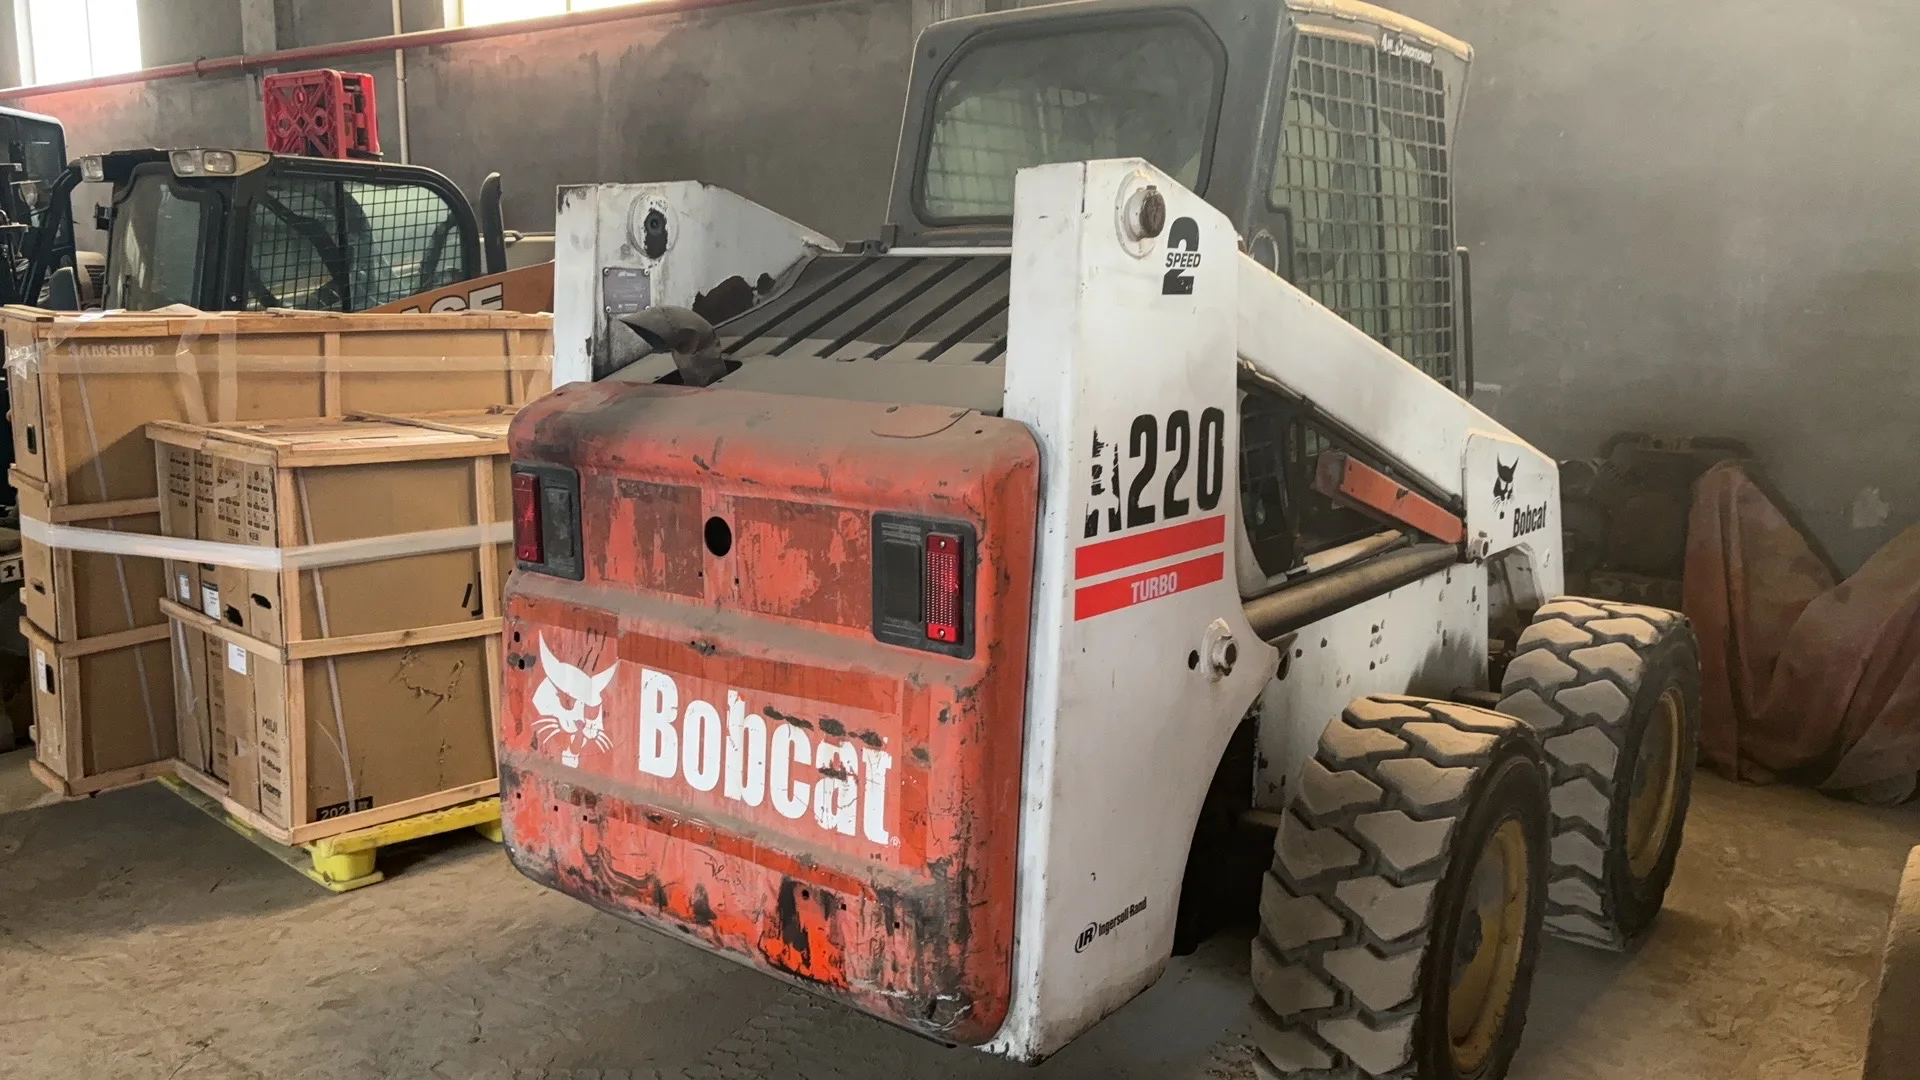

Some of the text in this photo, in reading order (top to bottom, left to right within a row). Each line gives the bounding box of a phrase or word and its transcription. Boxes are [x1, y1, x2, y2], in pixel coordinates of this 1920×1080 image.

[1162, 216, 1200, 295] 2
[1165, 252, 1202, 268] SPEED
[1084, 406, 1225, 539] A220
[1512, 500, 1548, 539] Bobcat
[1131, 571, 1178, 604] TURBO
[638, 668, 894, 846] Bobcat
[1078, 896, 1147, 950] IR Ingersoll Rand
